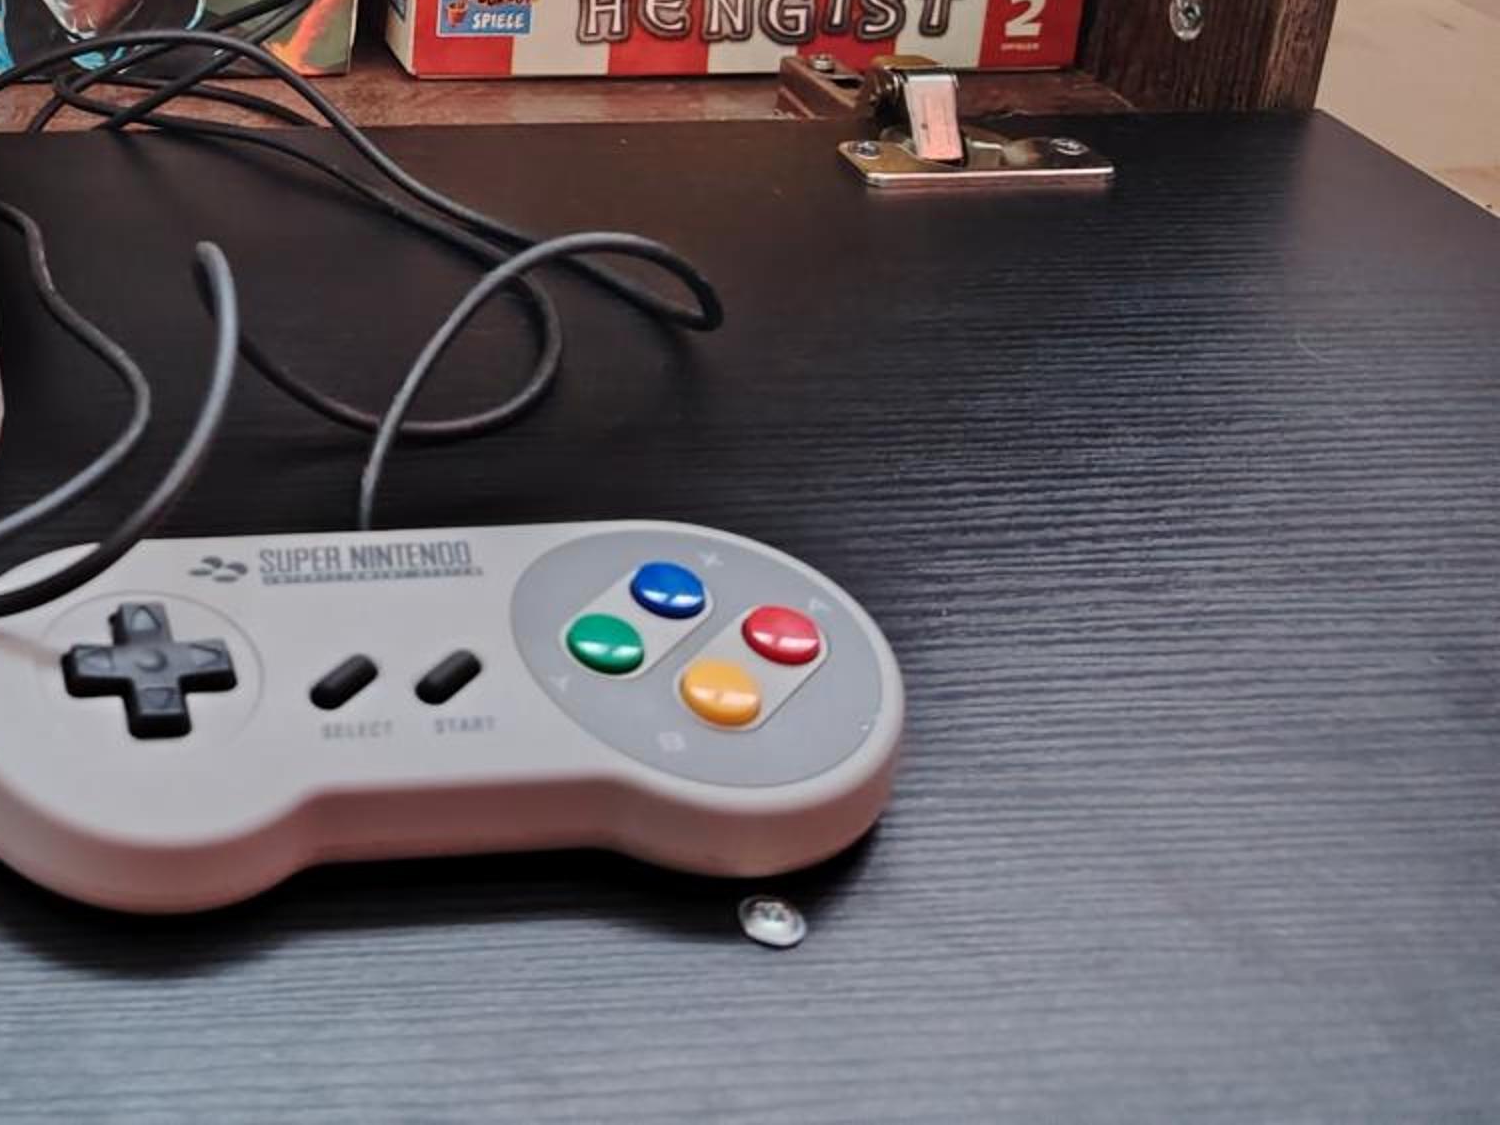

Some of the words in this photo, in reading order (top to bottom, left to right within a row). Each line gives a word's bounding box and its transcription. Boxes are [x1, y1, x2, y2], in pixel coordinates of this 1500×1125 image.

[259, 546, 342, 575] SUPER
[349, 540, 473, 570] NINTENDO
[320, 721, 394, 740] SELECT
[434, 715, 496, 735] START
